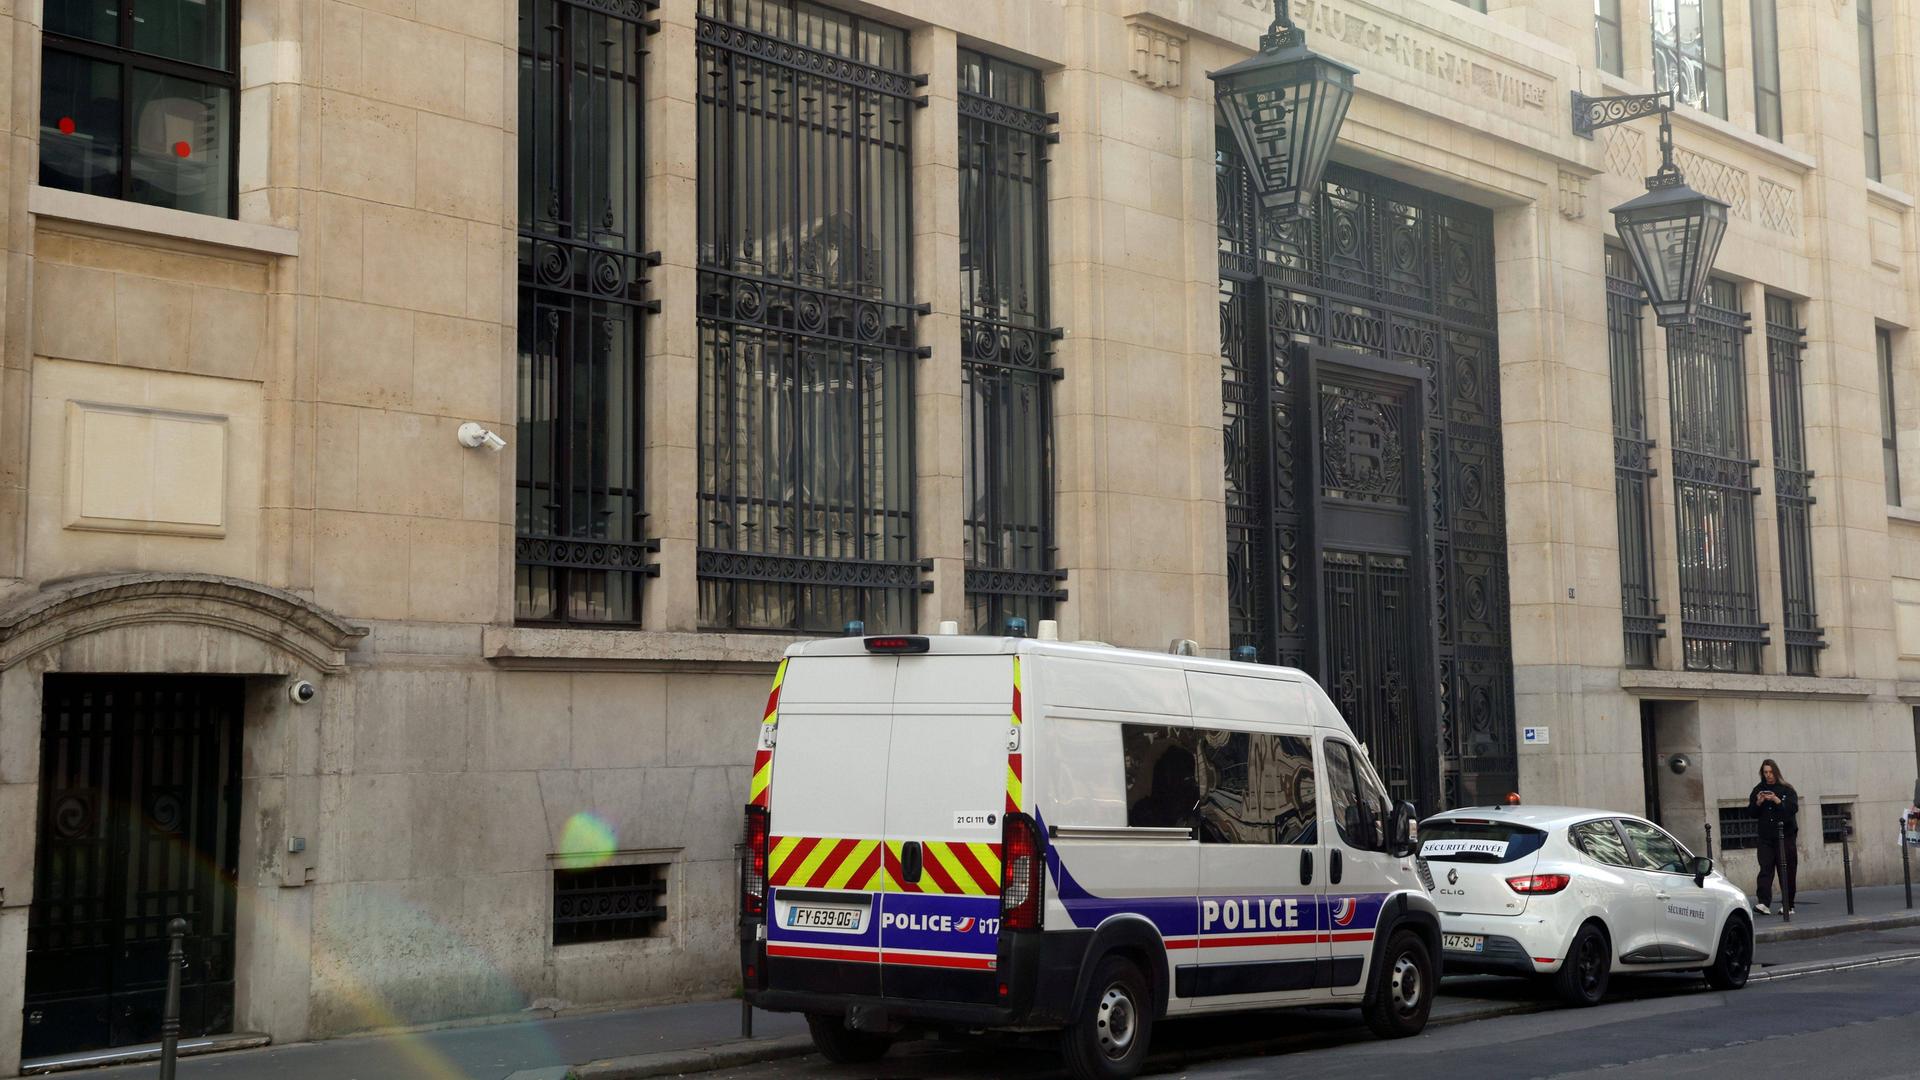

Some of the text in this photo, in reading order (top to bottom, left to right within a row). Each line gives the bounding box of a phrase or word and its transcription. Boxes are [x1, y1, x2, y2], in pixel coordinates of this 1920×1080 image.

[1246, 88, 1287, 190] POSTES
[1424, 841, 1503, 852] SÉCURITÉ PRIVÉE
[882, 912, 952, 932] POLICE
[1202, 898, 1299, 930] POLICE
[986, 918, 1000, 935] 17
